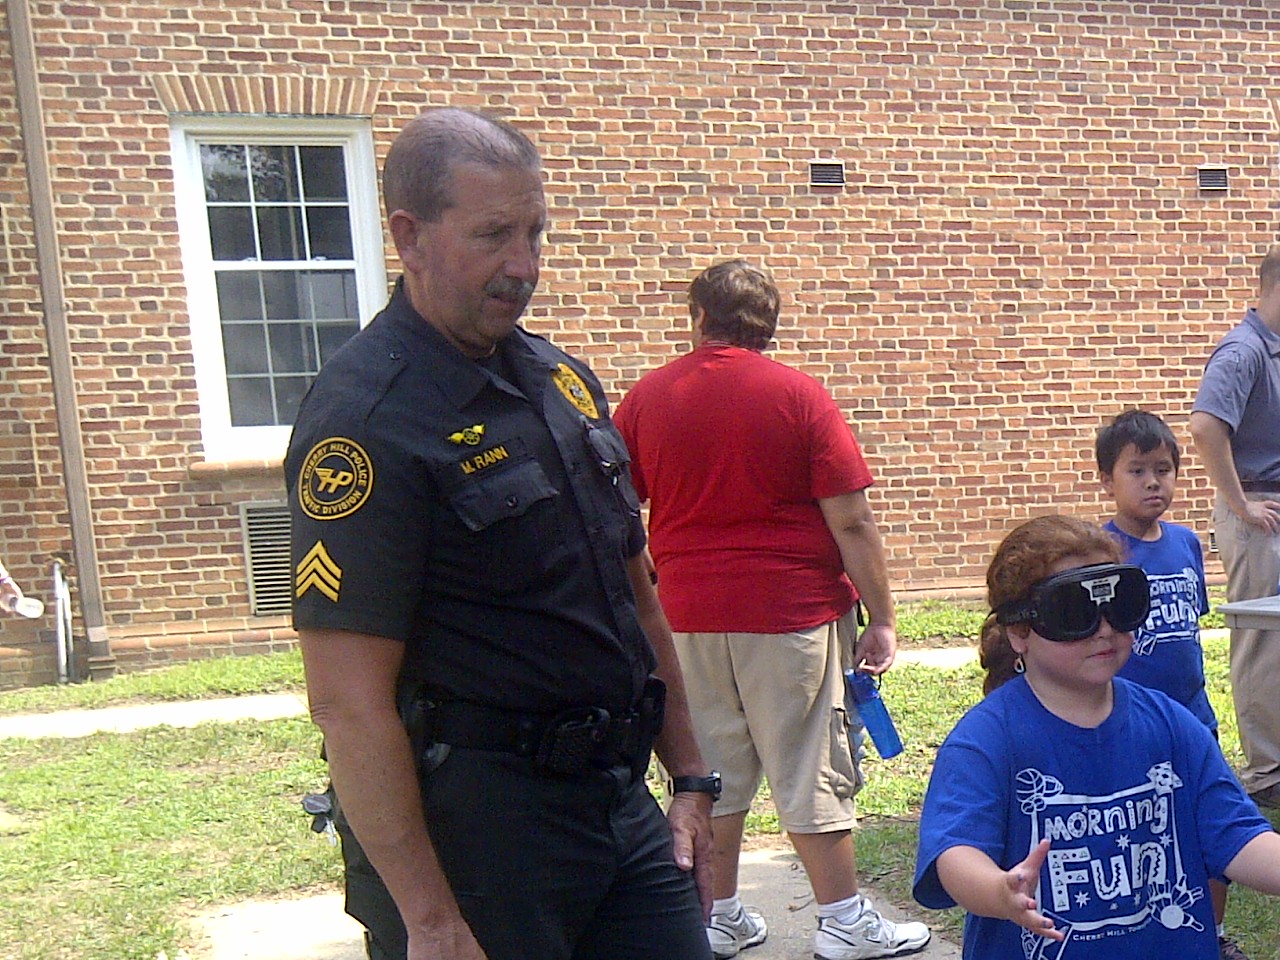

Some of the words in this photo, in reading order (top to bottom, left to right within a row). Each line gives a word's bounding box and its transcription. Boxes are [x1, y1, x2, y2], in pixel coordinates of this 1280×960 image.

[330, 443, 350, 454] HILL
[350, 451, 367, 487] POLICE
[474, 446, 509, 469] RANN
[1048, 842, 1167, 913] Fun
